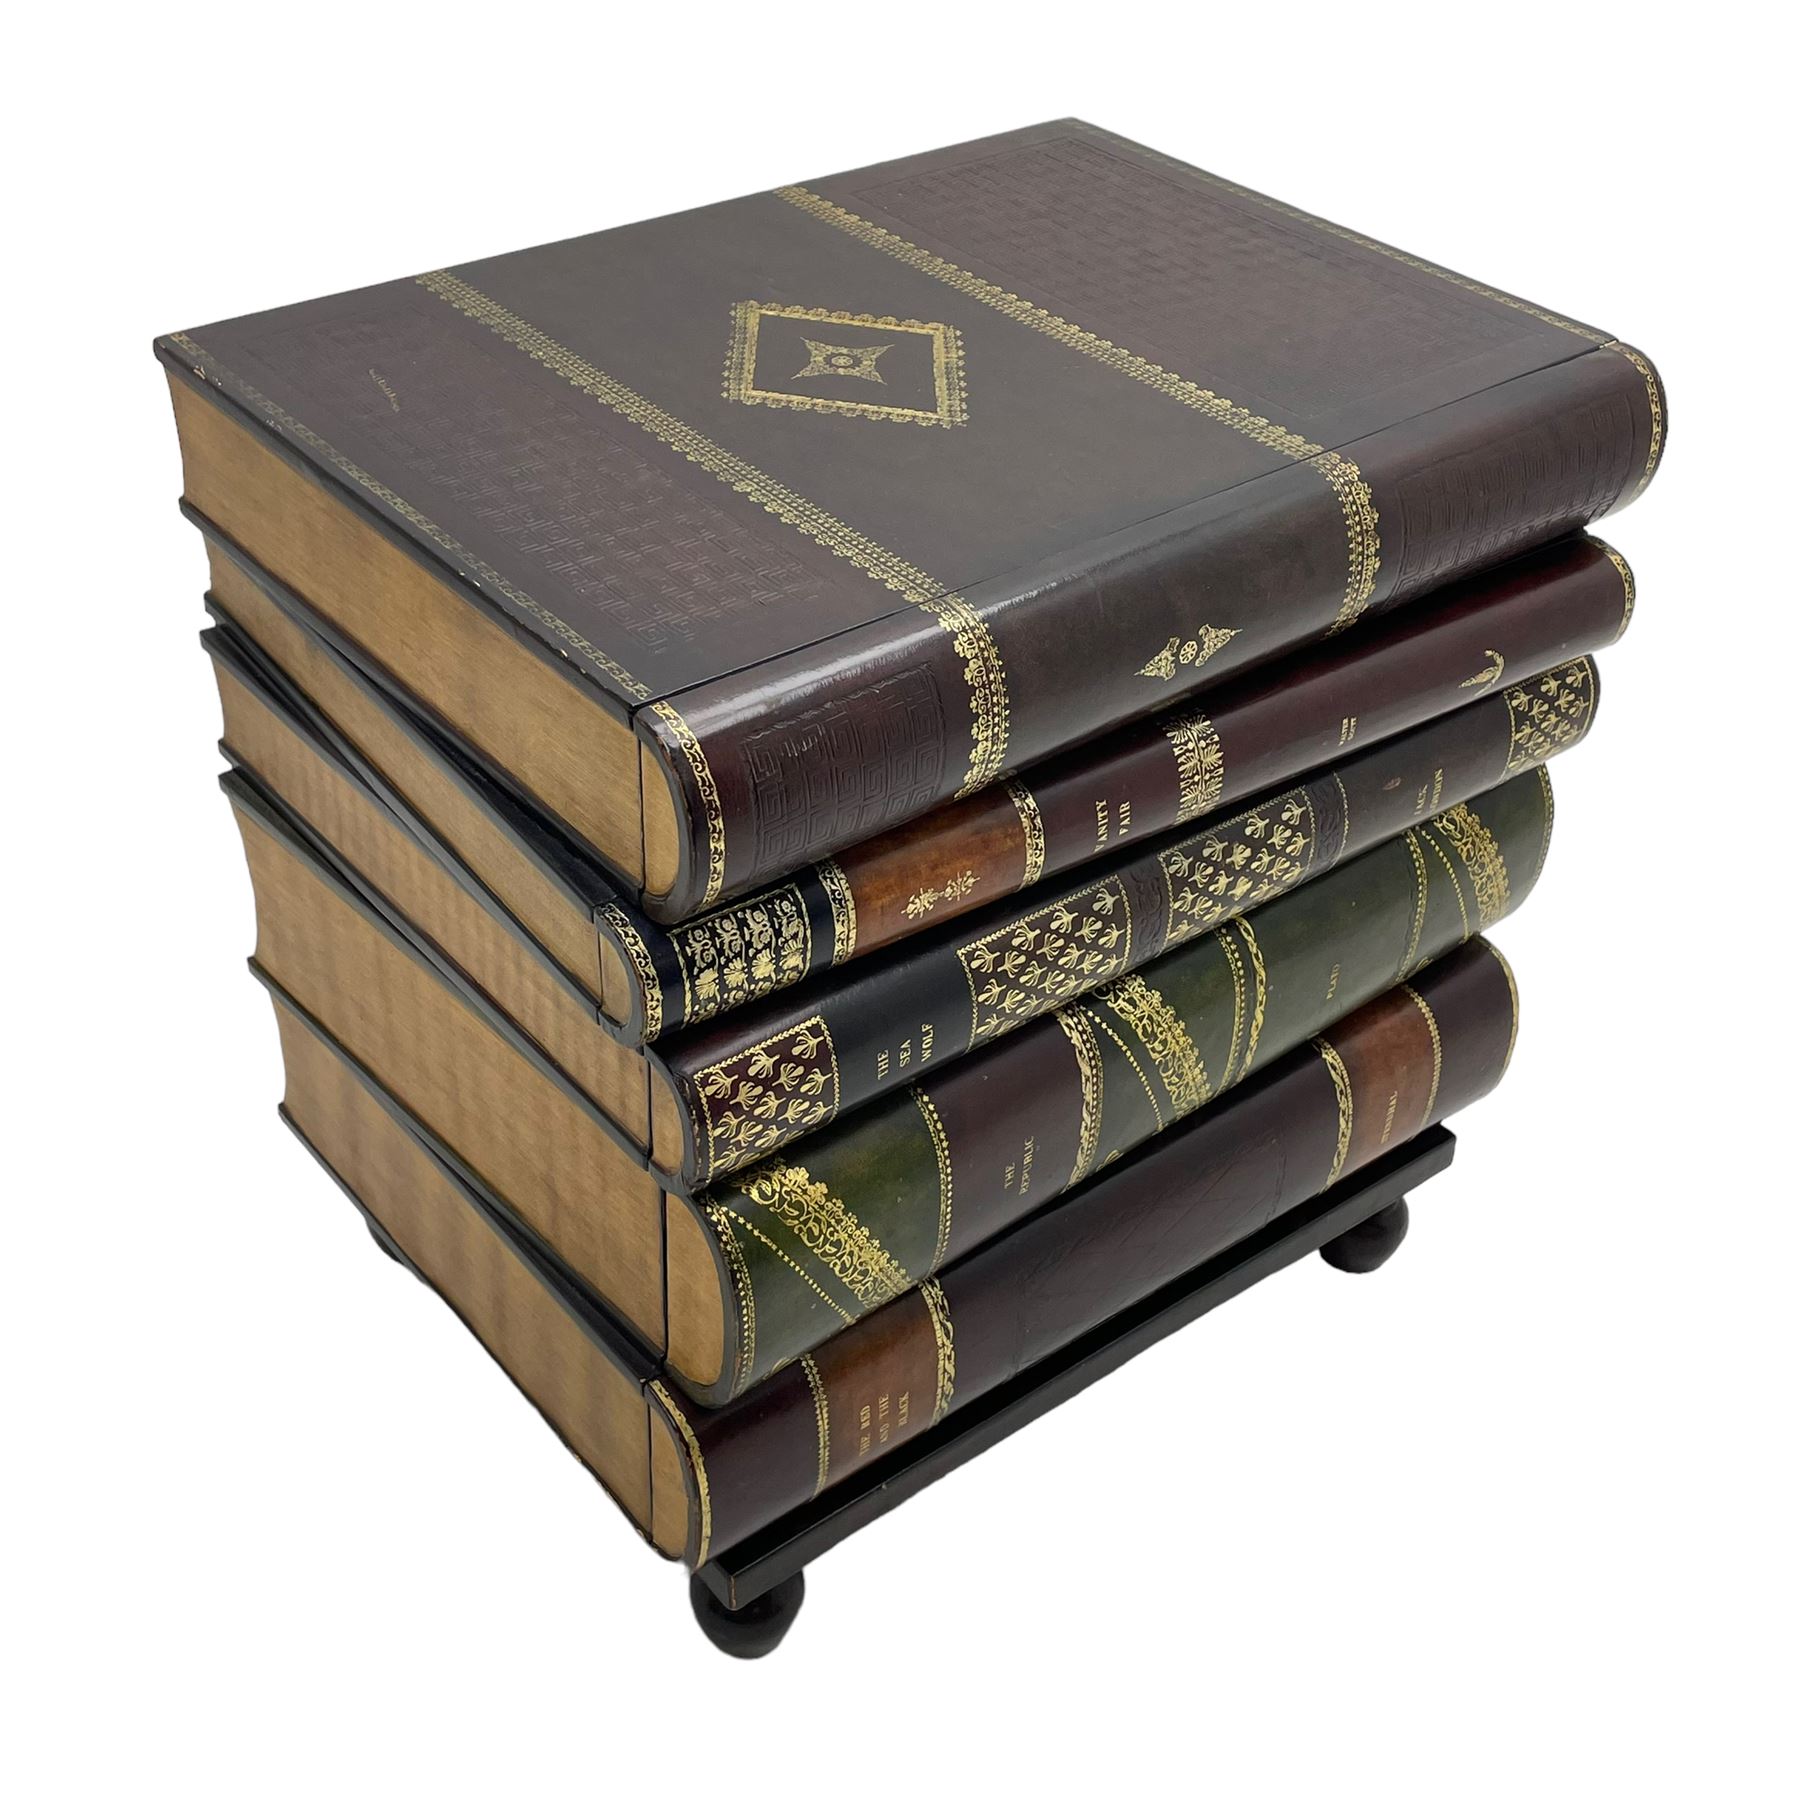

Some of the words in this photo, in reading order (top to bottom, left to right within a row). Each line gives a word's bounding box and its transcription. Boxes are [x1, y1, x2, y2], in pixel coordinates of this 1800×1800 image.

[1094, 799, 1109, 852] VANITY
[1119, 800, 1132, 836] FAIR
[1326, 963, 1341, 1000] PLATO
[899, 1038, 912, 1068] SEA
[920, 1023, 934, 1062] WOLF
[877, 1048, 889, 1080] THE
[1003, 1162, 1015, 1189] THE
[1019, 1136, 1035, 1196] REPUBLIC
[859, 1405, 871, 1431] RED
[878, 1393, 889, 1421] THE
[897, 1391, 909, 1428] BLACK
[859, 1433, 871, 1457] THE
[880, 1422, 889, 1443] AND
